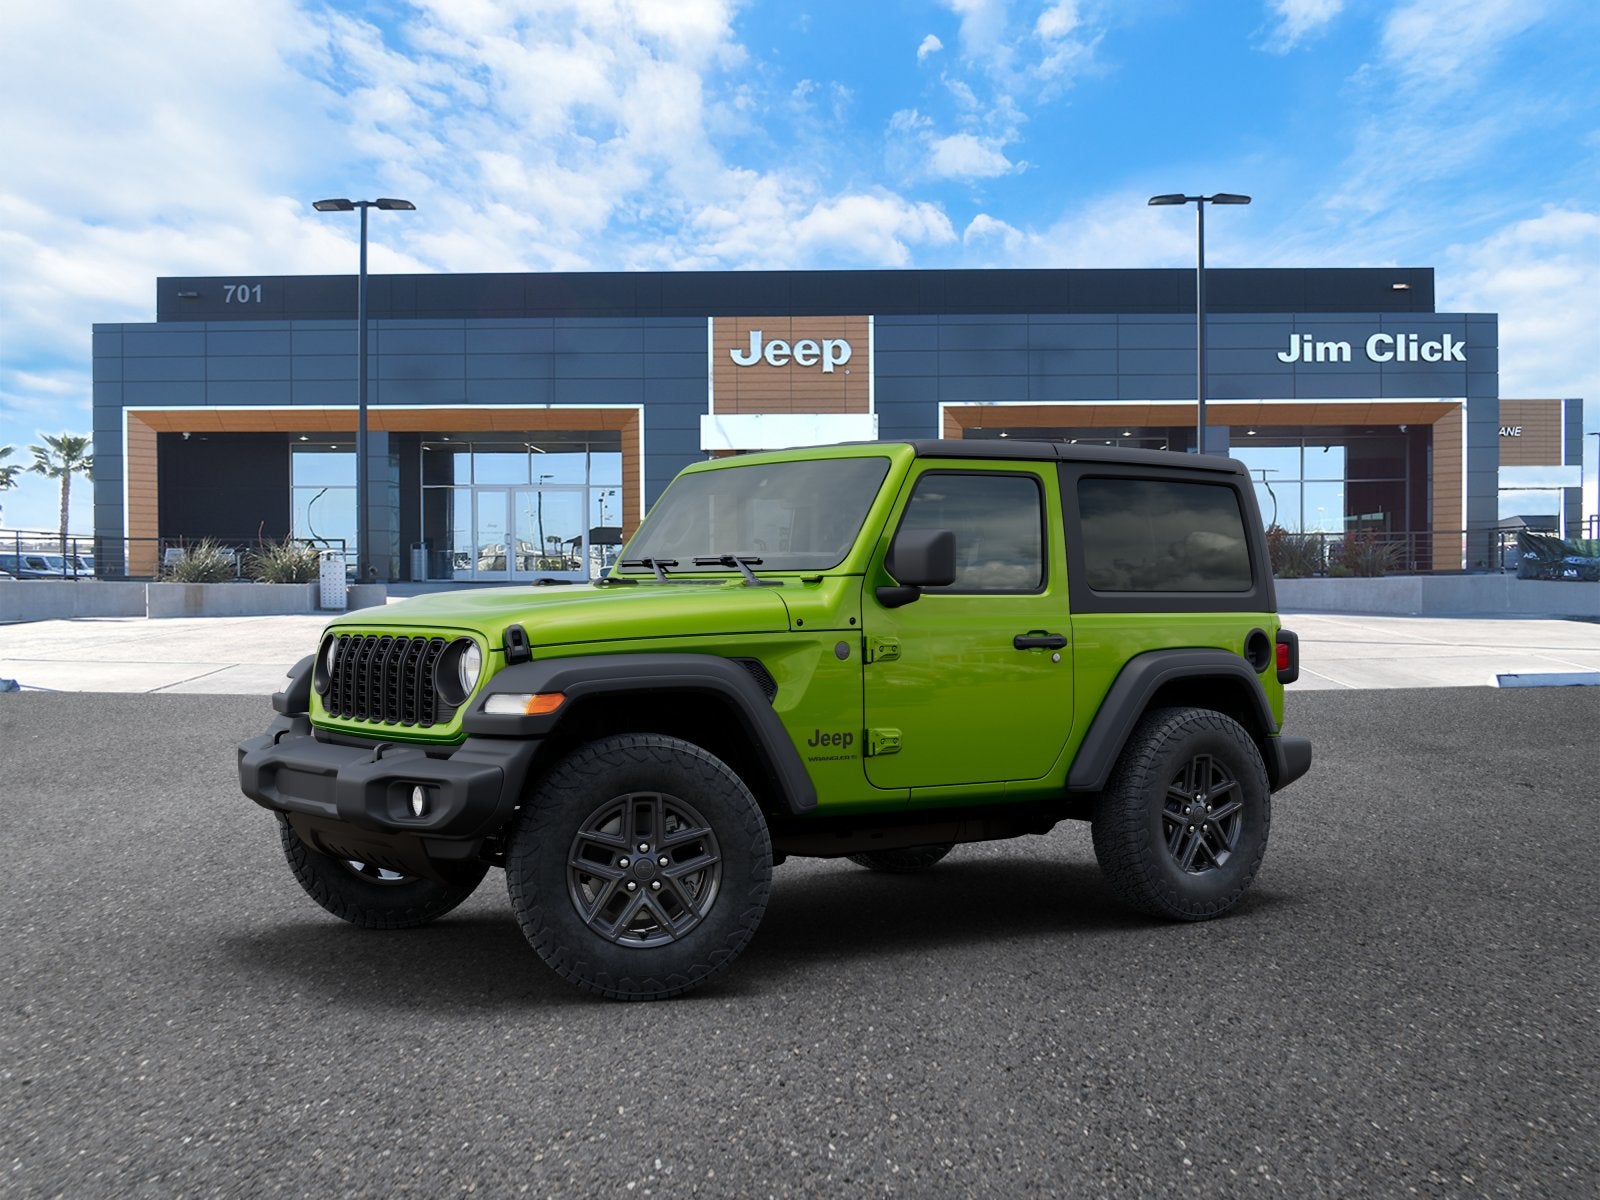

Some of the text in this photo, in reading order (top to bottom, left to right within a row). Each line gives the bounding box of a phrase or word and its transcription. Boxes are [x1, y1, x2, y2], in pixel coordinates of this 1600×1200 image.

[223, 284, 262, 304] 701
[729, 330, 852, 373] Jeep
[1277, 333, 1467, 363] Jim Click
[807, 729, 854, 749] Jeep
